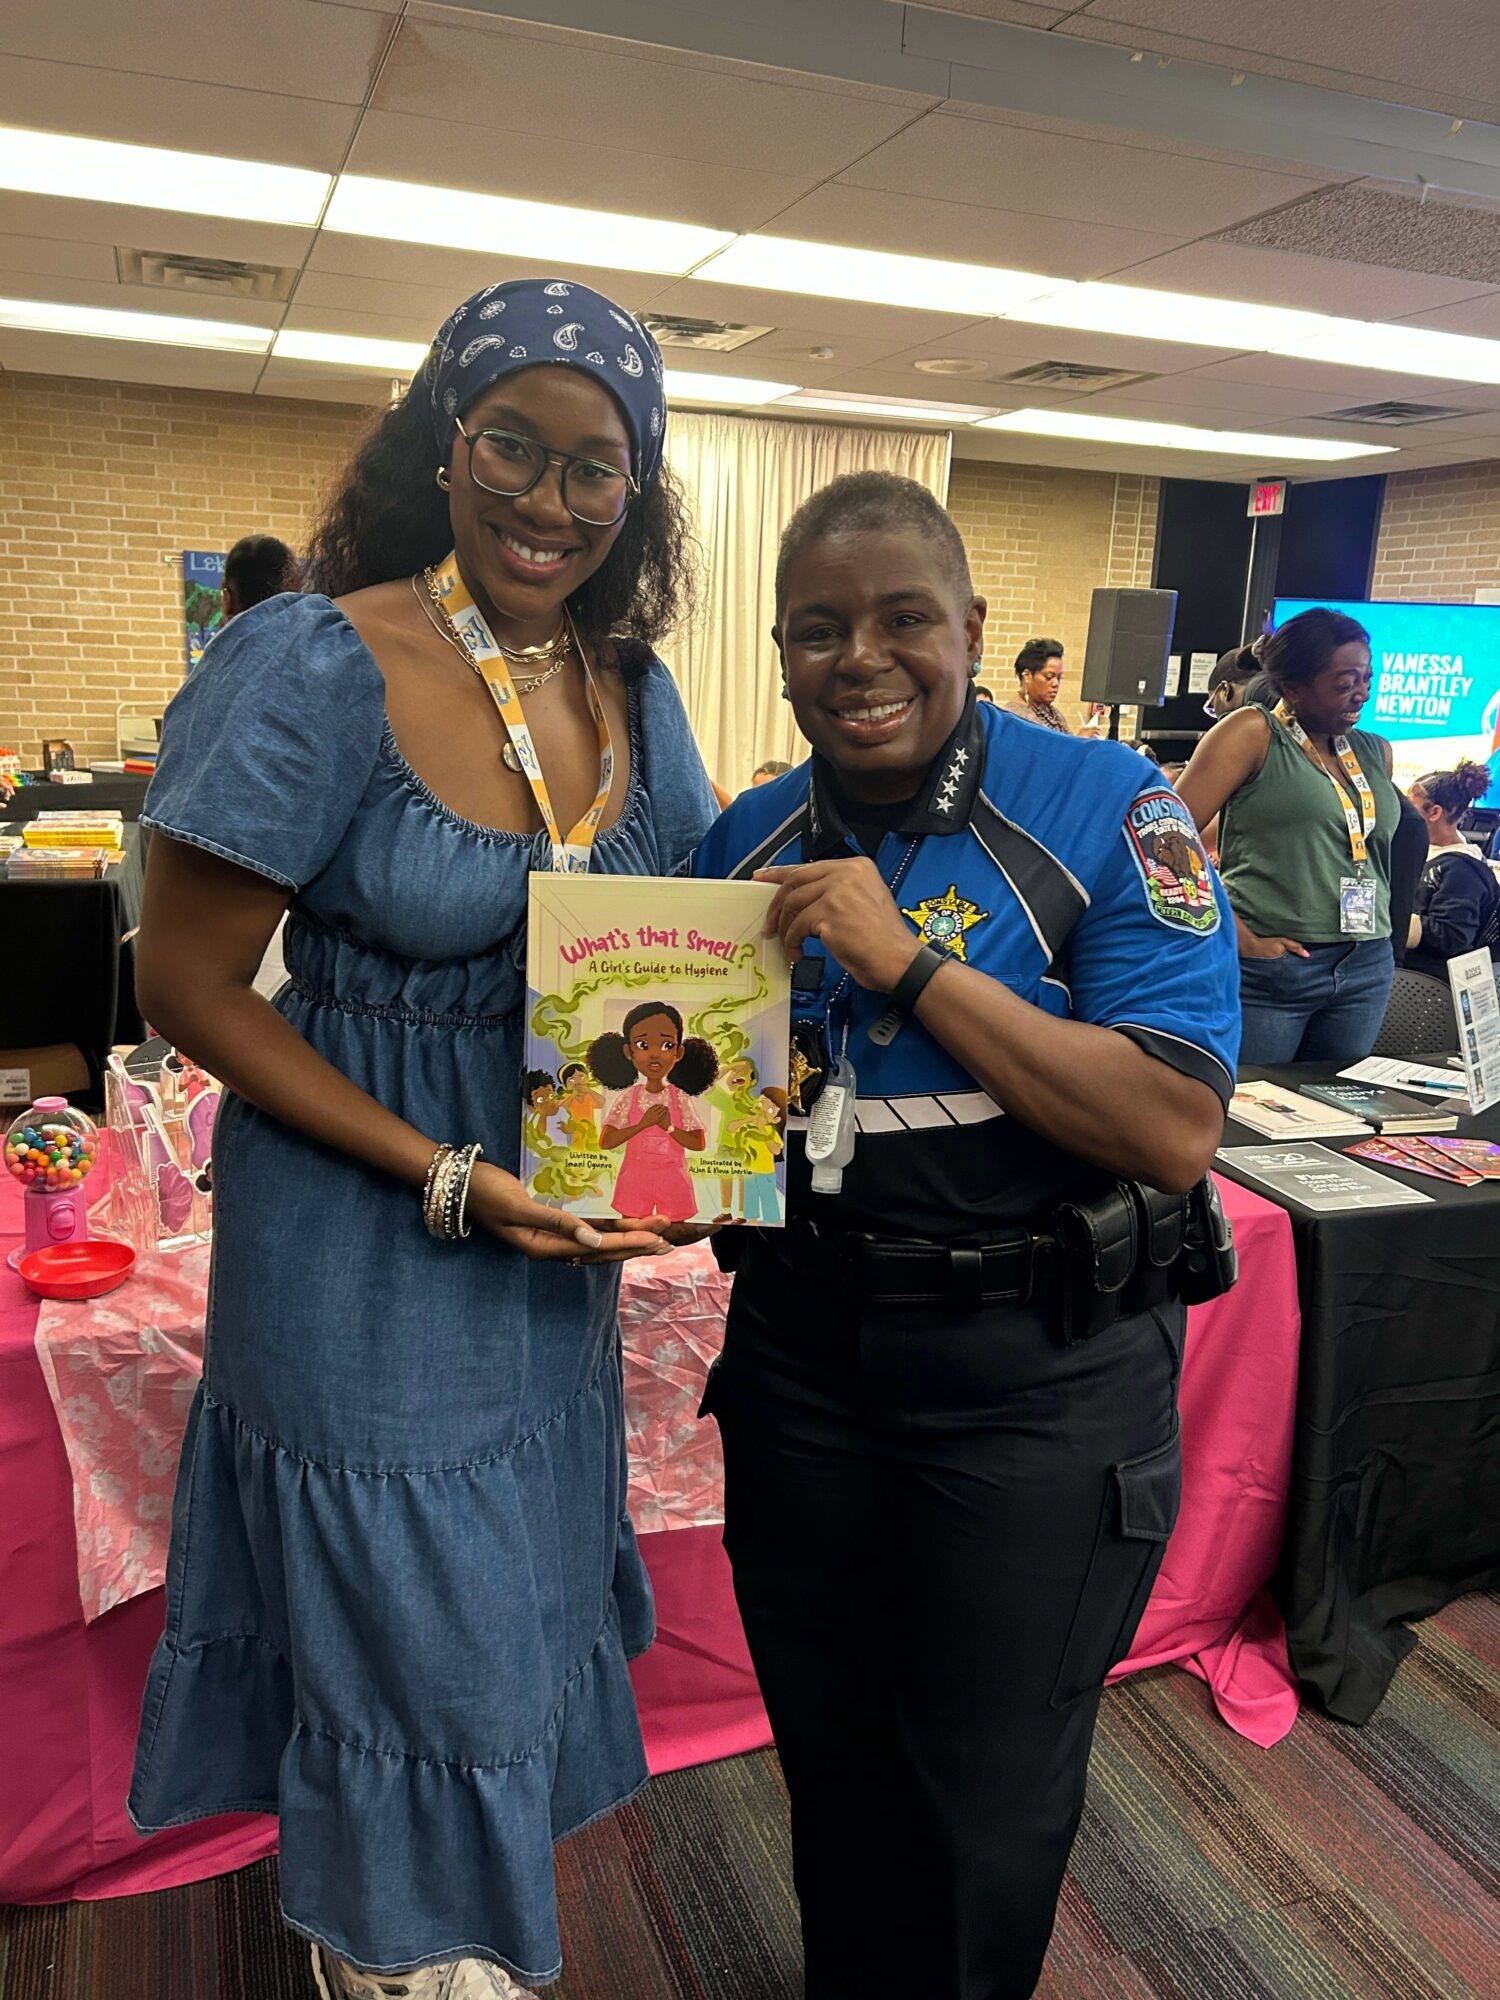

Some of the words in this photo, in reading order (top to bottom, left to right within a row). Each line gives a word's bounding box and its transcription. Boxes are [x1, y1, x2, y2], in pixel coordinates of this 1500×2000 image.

[1382, 652, 1463, 676] VANESSA
[1378, 673, 1473, 698] BRANTLEY
[1375, 694, 1452, 718] NEWTON
[924, 898, 974, 911] CONSTABLE
[924, 912, 940, 931] STATE
[951, 911, 963, 933] TEXAS
[560, 928, 631, 964] What's
[636, 925, 679, 948] that
[687, 929, 756, 970] Smell?
[589, 960, 597, 973] A
[601, 960, 631, 974] Girl's
[634, 961, 666, 975] Guide
[669, 964, 681, 975] to
[685, 964, 728, 977] Hygiene
[565, 1159, 585, 1168] Imani
[569, 1152, 598, 1160] Written
[700, 1158, 733, 1166] Illustrated
[734, 1160, 742, 1168] by
